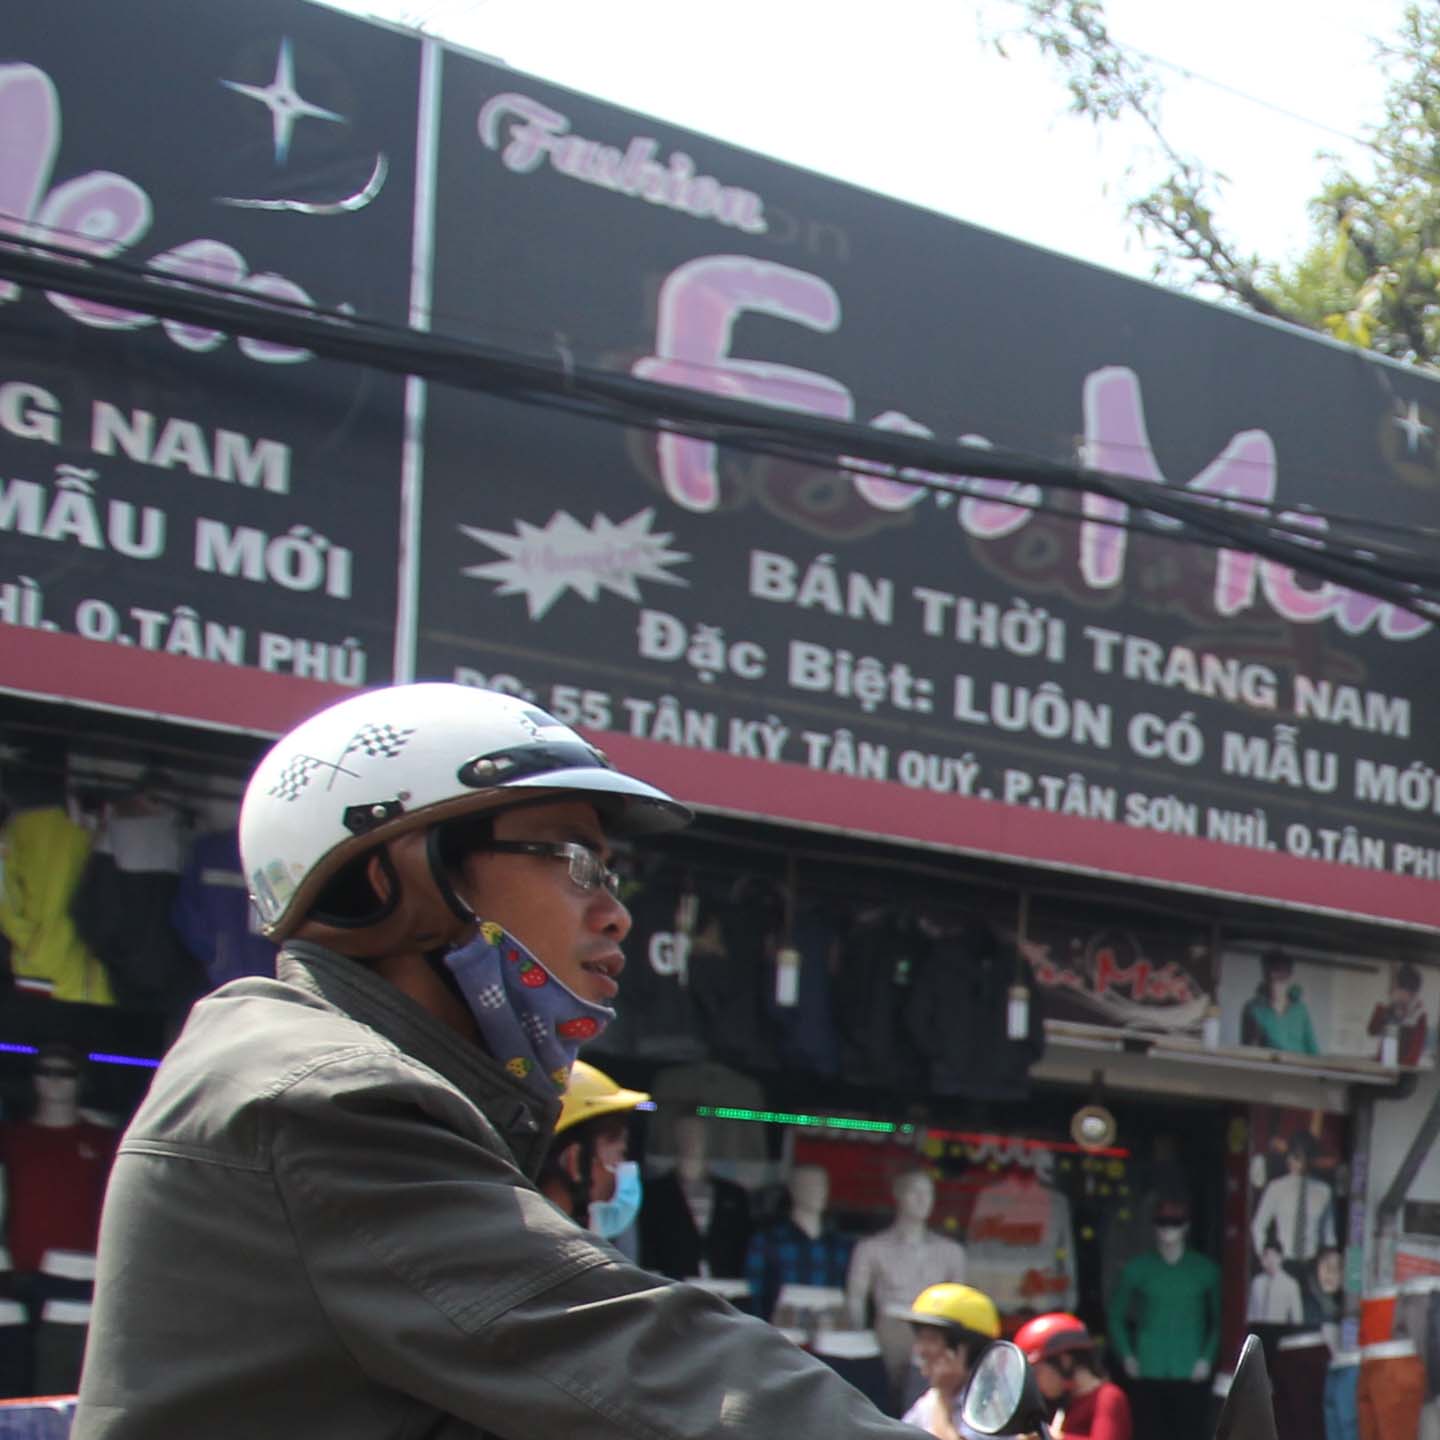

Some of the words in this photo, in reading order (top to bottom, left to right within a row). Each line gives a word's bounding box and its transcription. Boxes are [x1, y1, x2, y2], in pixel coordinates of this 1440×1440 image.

[90, 400, 292, 495] NAM
[193, 516, 354, 601] MỚI
[258, 630, 368, 689] PHÚ
[636, 607, 767, 684] Đặc
[788, 638, 935, 714] Biệt:
[953, 673, 1112, 749] LUÔN
[1127, 710, 1205, 766] CÓ
[1221, 723, 1339, 793] MẪU
[750, 548, 895, 627] BÁN
[911, 595, 1066, 664] THỜI
[1084, 625, 1279, 710] TRANG
[1293, 673, 1412, 739] NAM
[621, 694, 719, 752] TÂN
[801, 727, 890, 782] TÂN
[1124, 791, 1198, 837] SƠN
